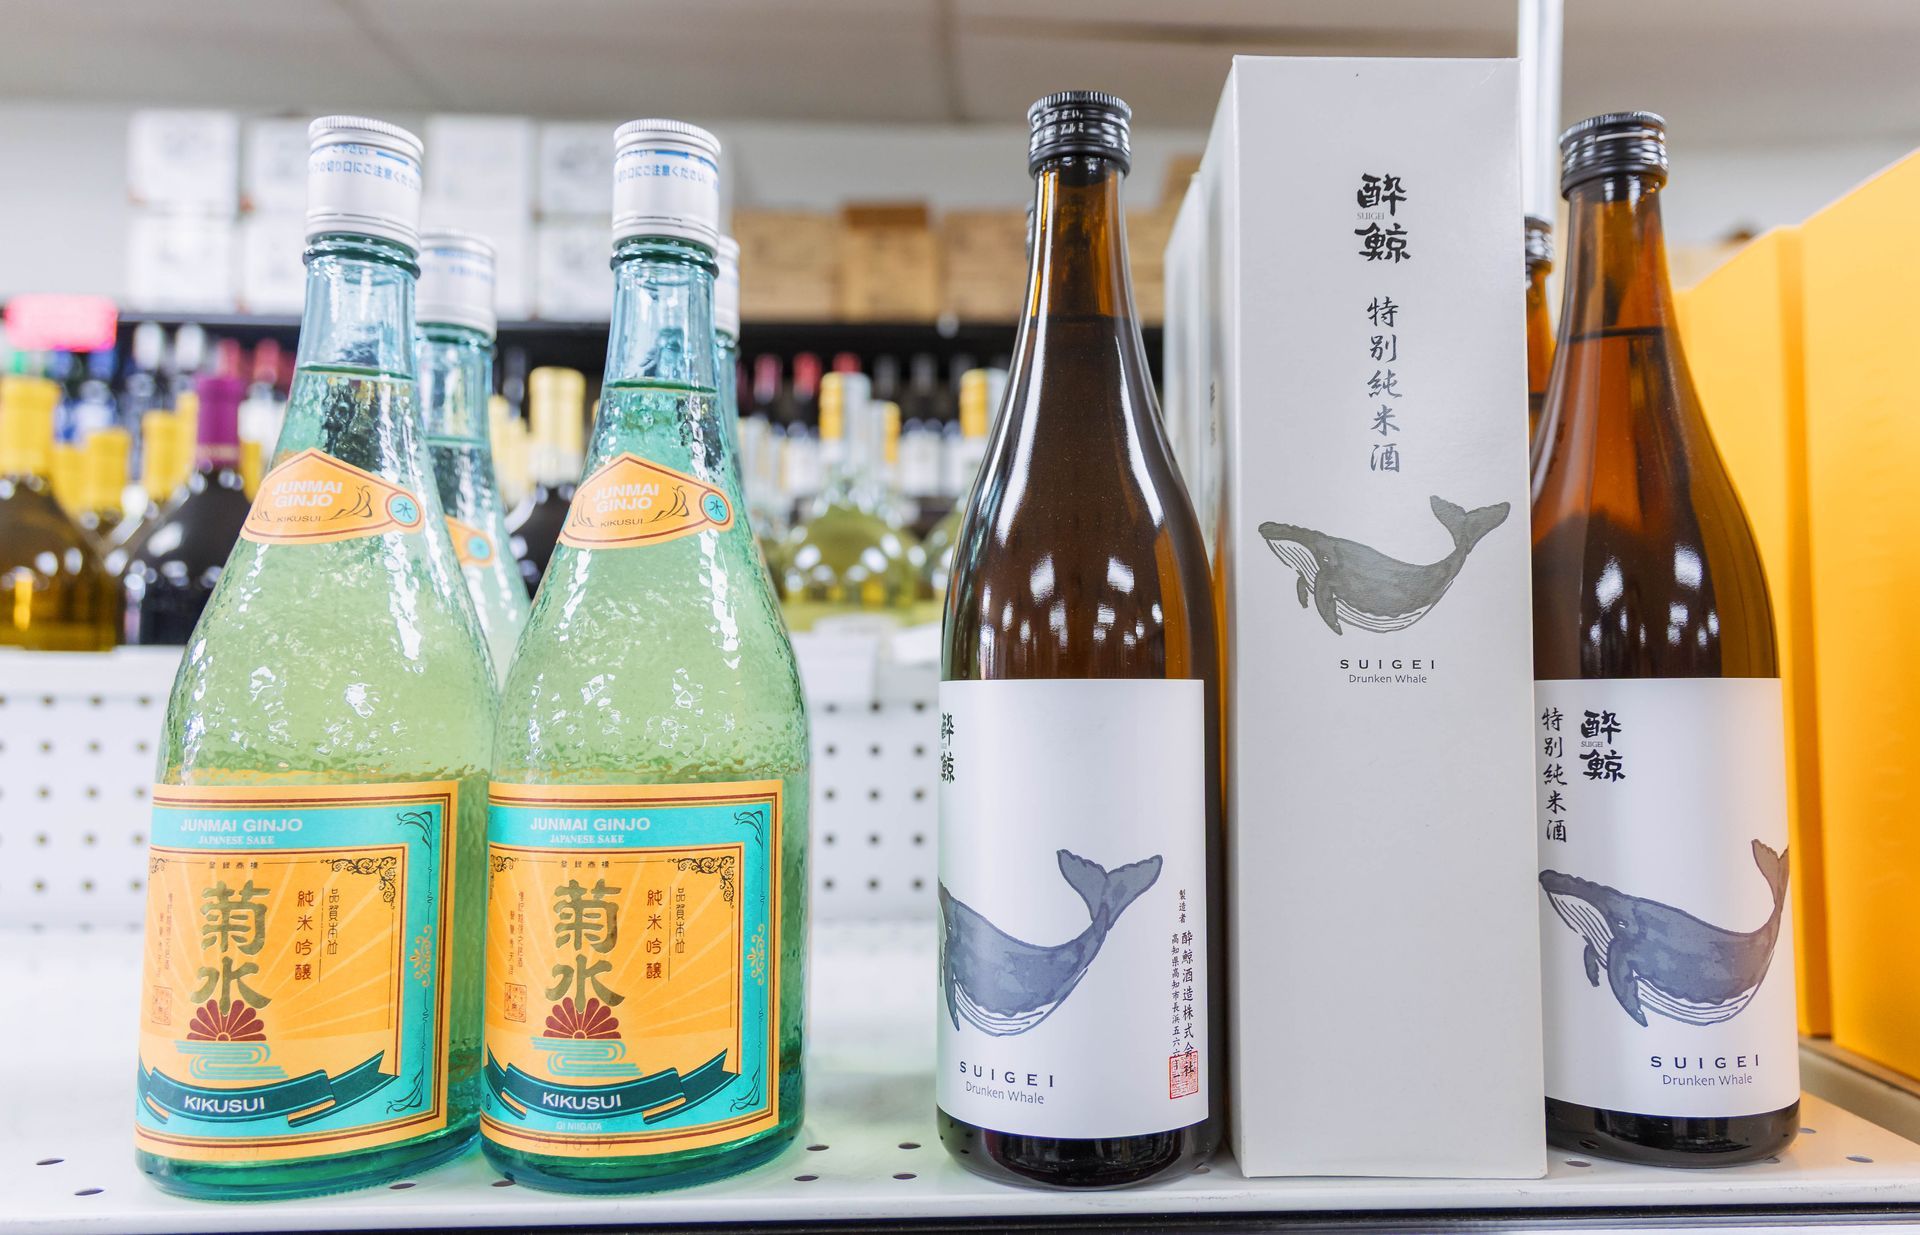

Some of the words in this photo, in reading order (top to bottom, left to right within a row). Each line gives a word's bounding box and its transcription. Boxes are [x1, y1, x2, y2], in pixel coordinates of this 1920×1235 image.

[1354, 173, 1411, 263] 酔鯨
[1356, 212, 1385, 220] SUIGEI
[1366, 296, 1403, 473] 特別純米酒
[271, 480, 343, 496] JUNMAI
[592, 482, 660, 502] JUNMAI
[274, 494, 334, 508] GINJO
[596, 496, 652, 513] GINJO
[277, 515, 322, 523] KIKUSUI
[600, 517, 644, 528] KIKUSUI
[1340, 659, 1435, 670] SUIGEI
[1349, 674, 1392, 683] Drunken
[1395, 674, 1427, 683] Whale
[1579, 709, 1626, 783] 酔鯨
[1541, 707, 1568, 843] 特別純米酒
[180, 818, 237, 832] JUNMAI
[242, 818, 304, 833] GINJO
[530, 817, 588, 831] JUNMAI
[593, 817, 651, 832] GINJO
[246, 835, 275, 844] SAKE
[551, 834, 594, 844] JAPANESE
[597, 834, 625, 844] SAKE
[190, 879, 274, 1016] 菊水
[544, 878, 626, 1015] 菊水
[1650, 1054, 1759, 1069] SUIGEI
[960, 1060, 1054, 1088] SUIGEI
[1662, 1074, 1715, 1086] Drunken
[1718, 1073, 1753, 1085] Whale
[965, 1080, 1005, 1101] Drunken
[1007, 1089, 1045, 1105] Whale
[184, 1095, 265, 1113] KIKUSUI
[542, 1092, 622, 1110] KIKUSUI
